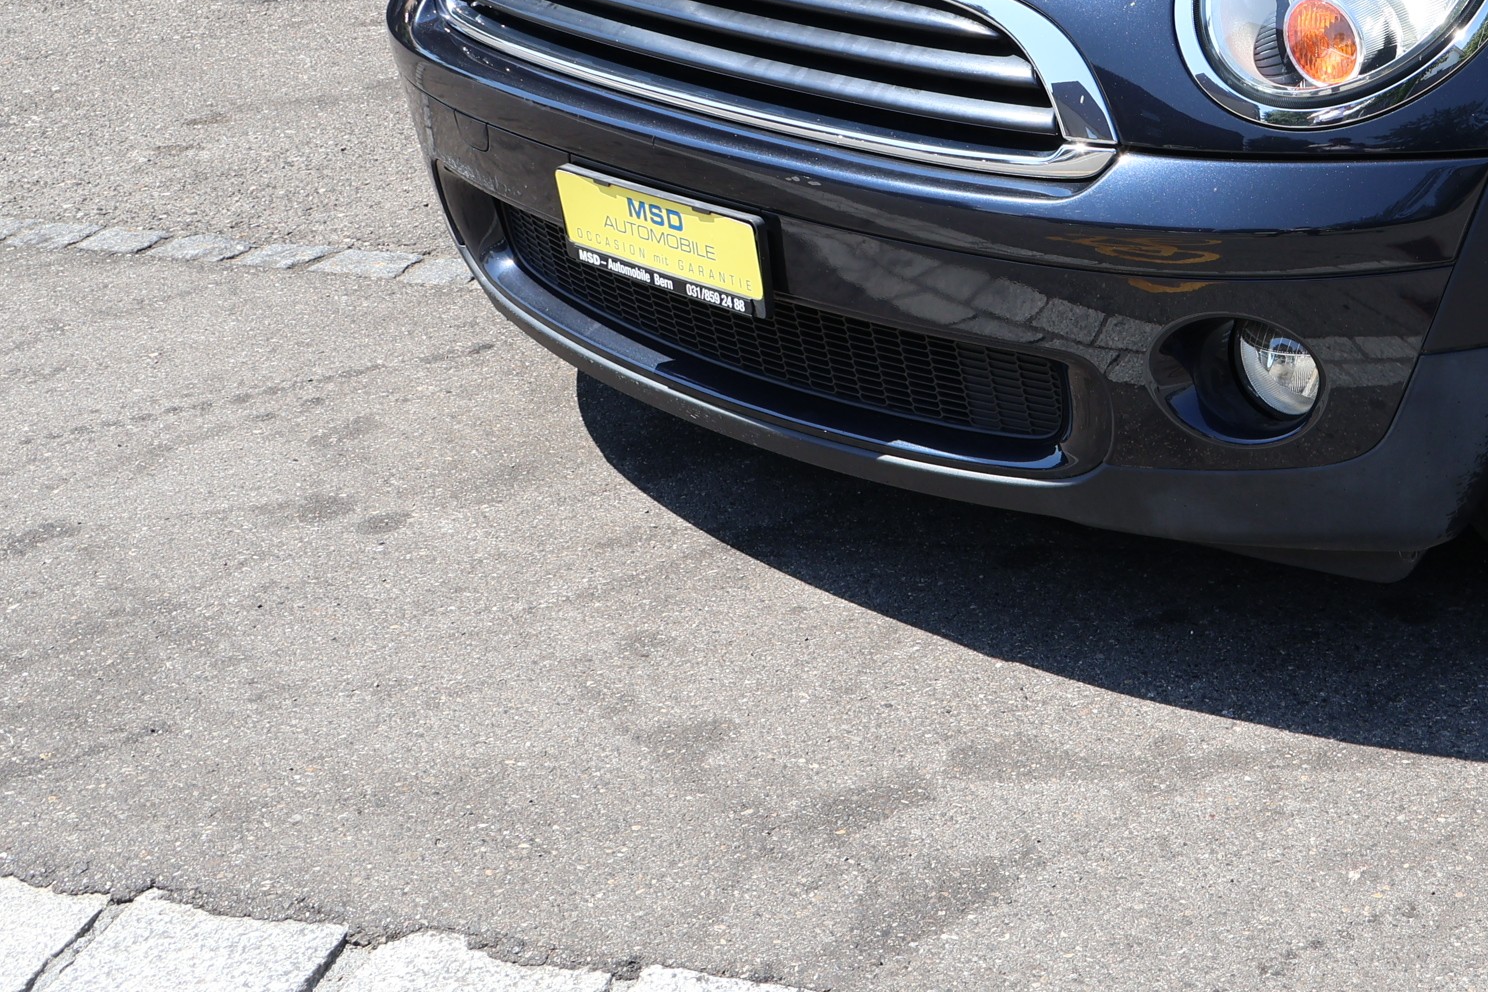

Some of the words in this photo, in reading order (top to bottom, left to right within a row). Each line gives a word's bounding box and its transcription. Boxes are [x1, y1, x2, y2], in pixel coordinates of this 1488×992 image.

[626, 196, 684, 232] MSD
[576, 226, 647, 259] OCCASION
[653, 253, 670, 267] mit
[677, 259, 753, 292] GARANTIE
[603, 215, 717, 262] AUTOMOBILE
[653, 273, 674, 291] Bern
[685, 283, 720, 305] 031/859
[720, 293, 733, 309] 24
[733, 295, 746, 313] 88
